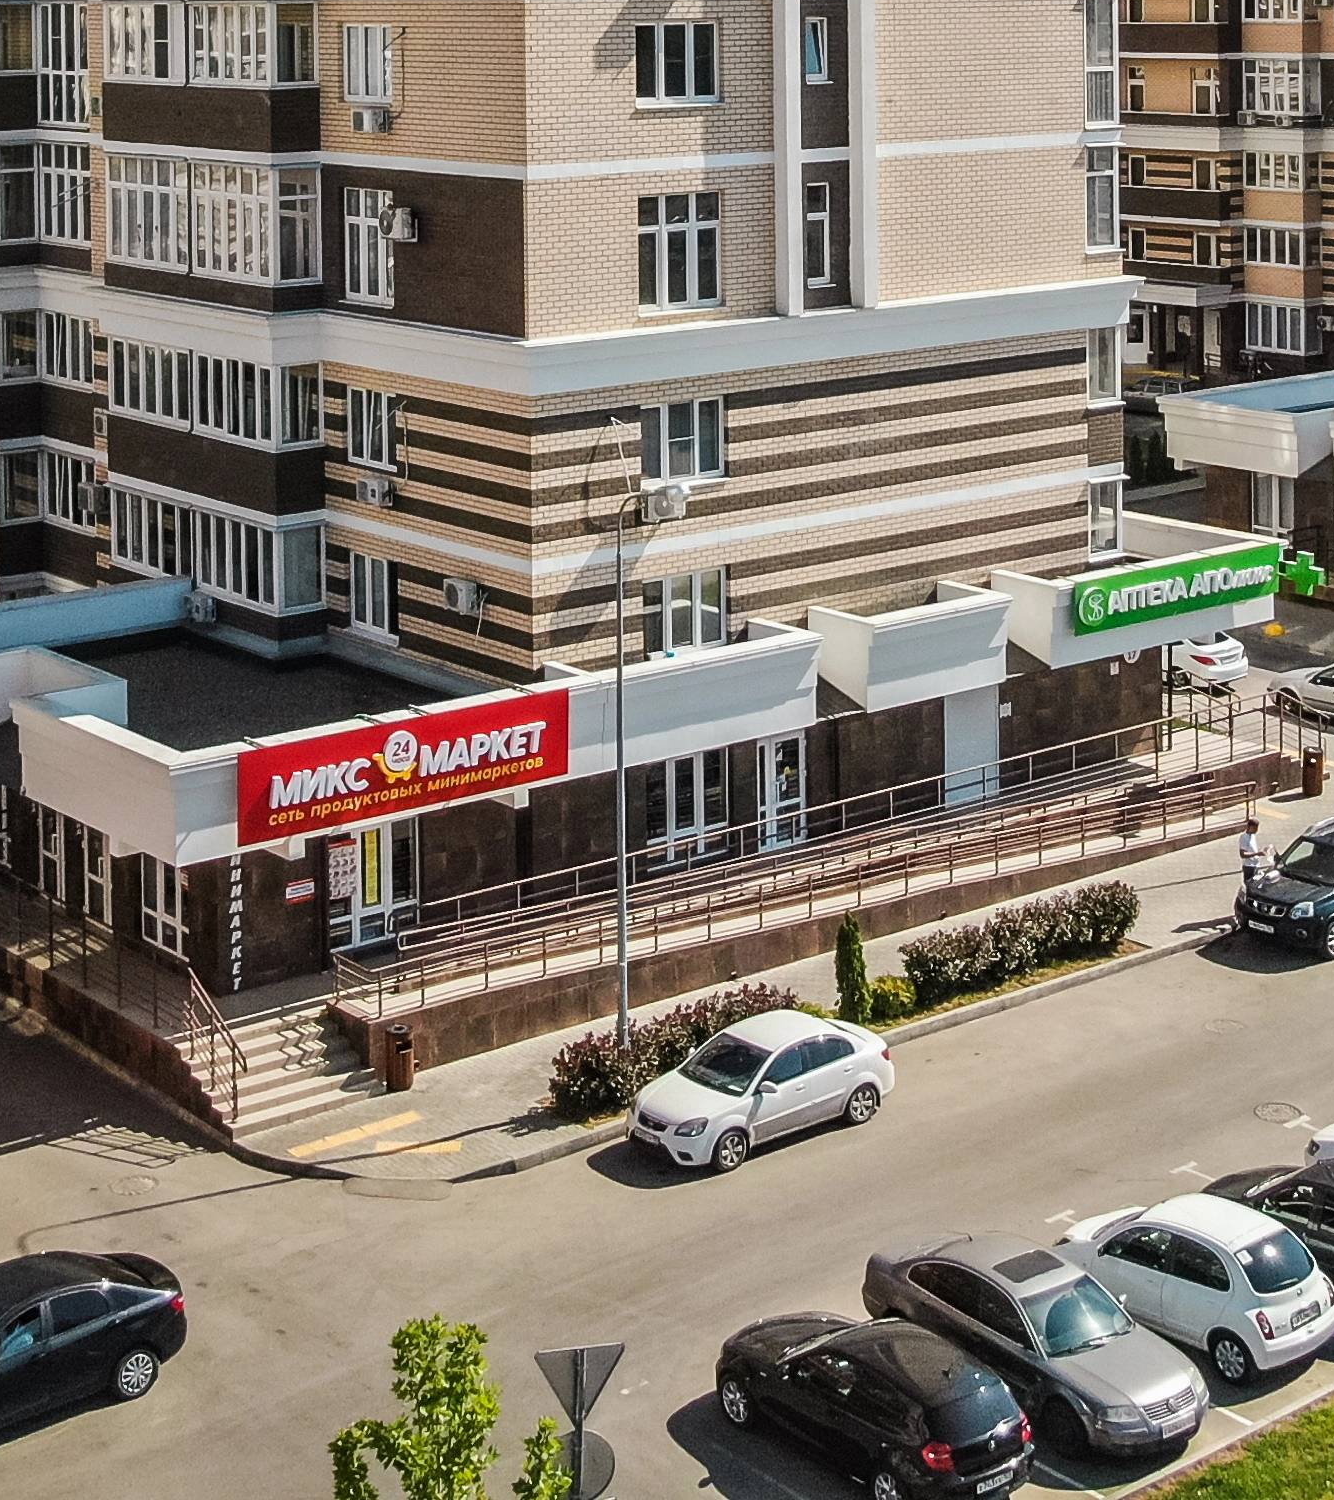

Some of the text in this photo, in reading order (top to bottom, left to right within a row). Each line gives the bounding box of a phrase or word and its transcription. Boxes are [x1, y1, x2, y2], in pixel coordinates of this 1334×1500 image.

[1108, 576, 1187, 615] АПТЕКА
[269, 720, 546, 809] МИКС МАРКЕТ
[392, 739, 411, 757] 24
[269, 756, 545, 826] сеть продуктовых минимаркетов
[229, 853, 244, 991] ИНИМАРКЕТ
